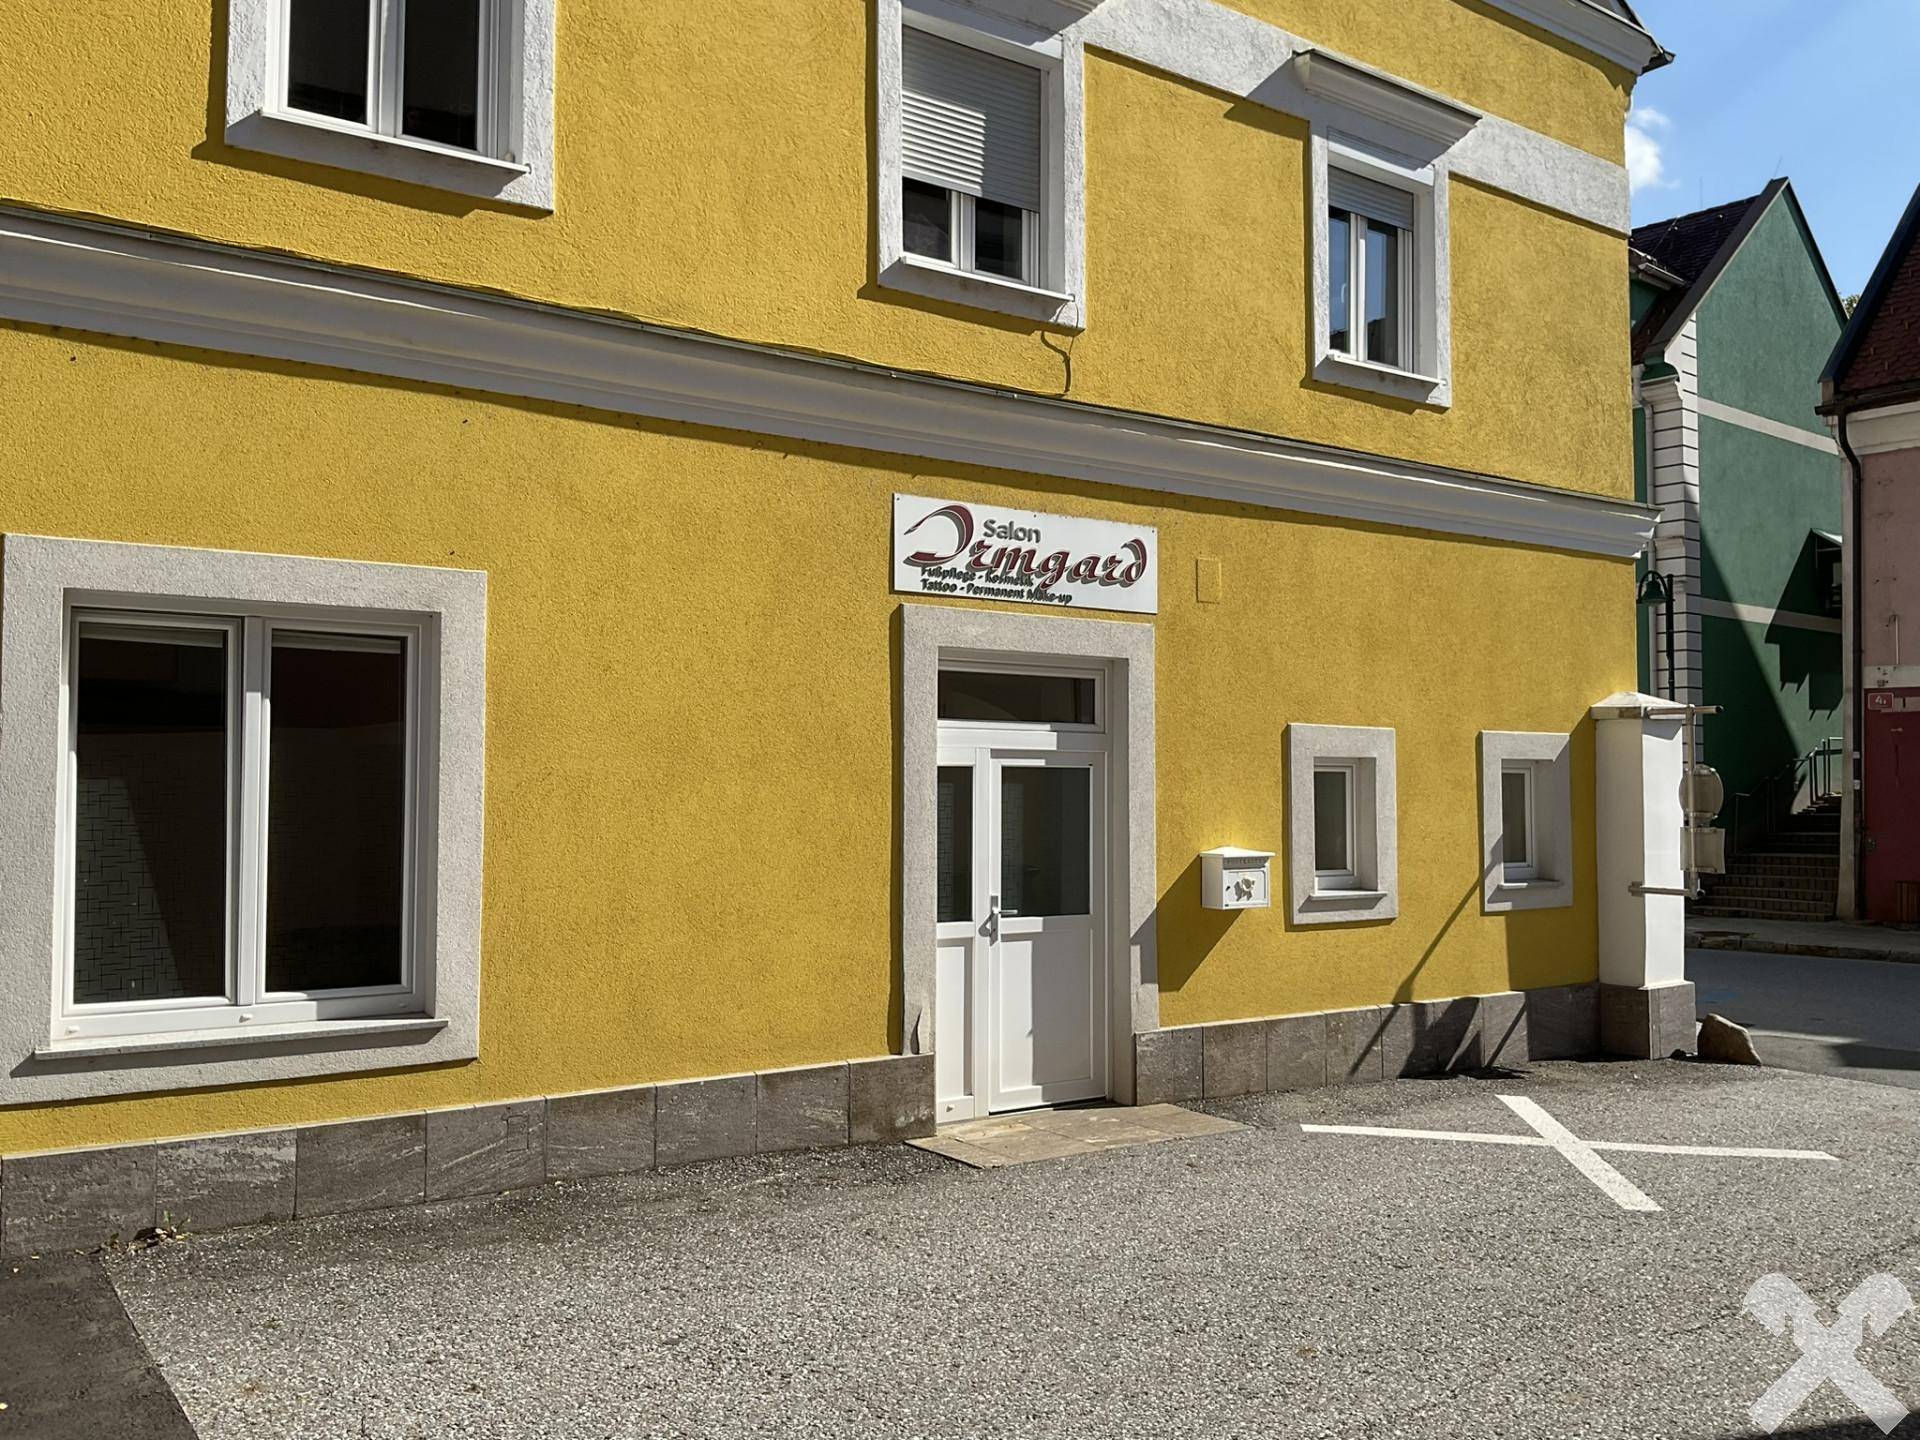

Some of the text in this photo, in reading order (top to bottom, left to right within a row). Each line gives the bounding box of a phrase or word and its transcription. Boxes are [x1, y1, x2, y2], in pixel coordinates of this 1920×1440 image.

[983, 518, 1041, 543] Salon
[920, 565, 976, 583] Fußpflege
[985, 567, 1034, 586] Kosmetik
[920, 578, 958, 592] Tattoo
[966, 583, 1025, 599] Permanent
[1025, 589, 1073, 605] Make-up
